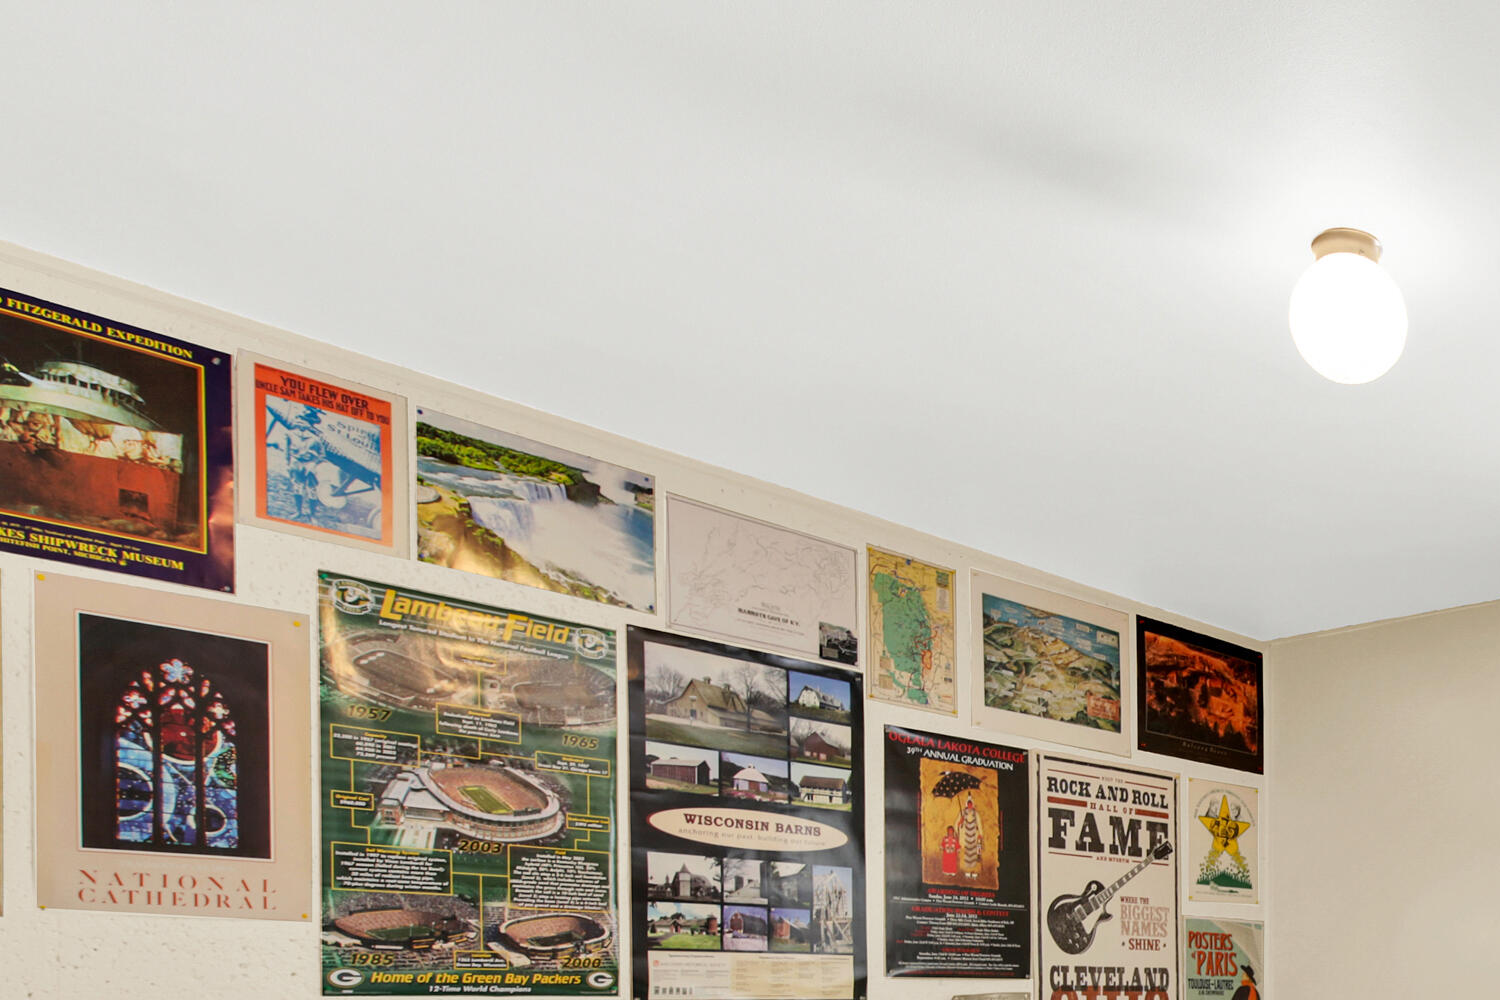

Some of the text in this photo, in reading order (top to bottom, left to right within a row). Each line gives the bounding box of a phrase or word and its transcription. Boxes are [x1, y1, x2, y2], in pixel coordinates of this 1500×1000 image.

[7, 297, 193, 359] FITZGERALD EXPEDITION
[280, 376, 369, 409] YOU FLEW OVER
[29, 532, 118, 558] SHIPWRECK
[122, 550, 185, 571] MUSEUM
[379, 588, 500, 630] Lambeau
[502, 612, 571, 645] Field
[347, 704, 392, 722] 1957
[563, 733, 599, 750] 1965
[888, 731, 1026, 764] OGLALA LAKOTA COLLEGE
[923, 749, 961, 763] ANNUAL
[961, 755, 1014, 771] GRADUATION
[1047, 776, 1169, 809] ROCK AND ROLL
[1090, 802, 1134, 815] HALL OF
[684, 813, 822, 837] WISCONSIN BARNS
[1048, 807, 1170, 862] FAME
[459, 838, 502, 855] 2003
[79, 869, 276, 894] NATIONAL
[78, 887, 276, 911] CATHEDRAL
[1120, 904, 1170, 922] BIGGEST
[1121, 920, 1168, 937] NAMES
[1128, 938, 1161, 951] SHINE
[1188, 930, 1234, 951] POSTERS
[350, 952, 395, 968] 1985
[563, 956, 603, 969] 2000
[1196, 950, 1239, 977] PARIS
[371, 972, 582, 987] Home of the Green Bay Packers
[1049, 965, 1170, 992] CLEVELAND
[463, 985, 488, 993] World
[489, 986, 532, 995] Champions
